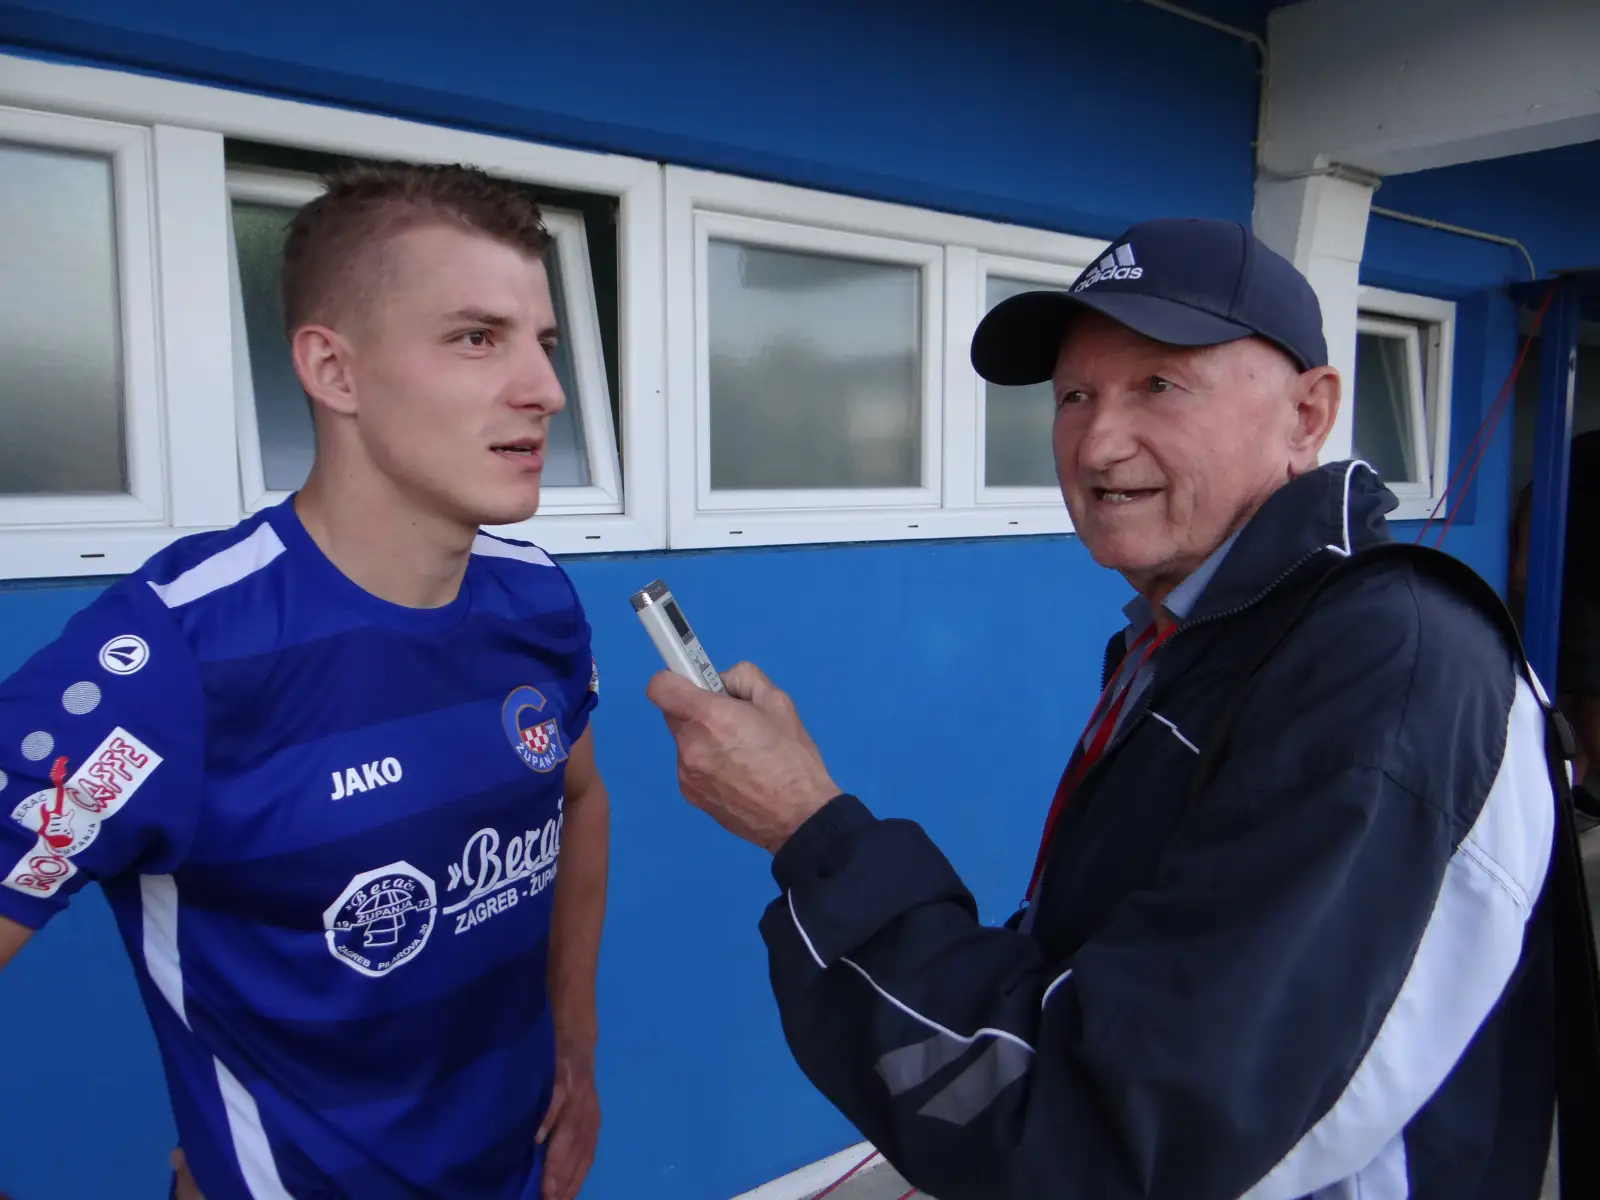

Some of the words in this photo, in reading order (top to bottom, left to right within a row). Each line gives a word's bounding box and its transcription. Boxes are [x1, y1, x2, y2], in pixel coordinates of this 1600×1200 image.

[1074, 266, 1143, 292] adidas
[66, 737, 148, 813] CAFFE
[331, 756, 403, 800] JAKO
[418, 898, 430, 908] 72
[454, 887, 519, 935] ZAGREB
[336, 944, 372, 968] ZAGREB
[377, 939, 422, 970] PILAROVA
